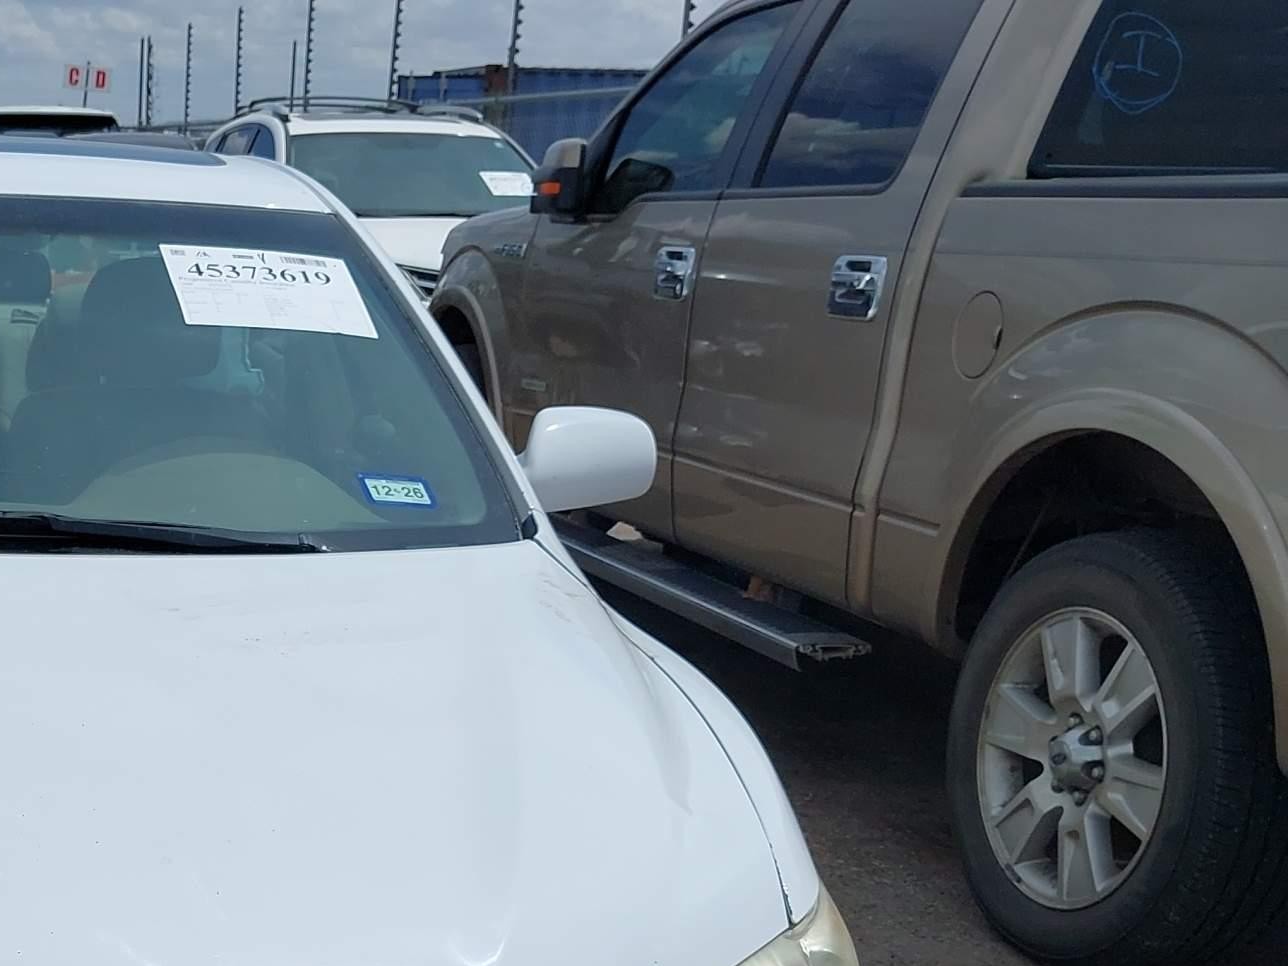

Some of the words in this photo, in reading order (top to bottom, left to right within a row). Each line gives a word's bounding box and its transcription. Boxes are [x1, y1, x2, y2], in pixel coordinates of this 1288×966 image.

[69, 67, 80, 87] C
[95, 70, 106, 89] D
[187, 262, 332, 286] 45373619
[371, 485, 424, 499] 12-26
